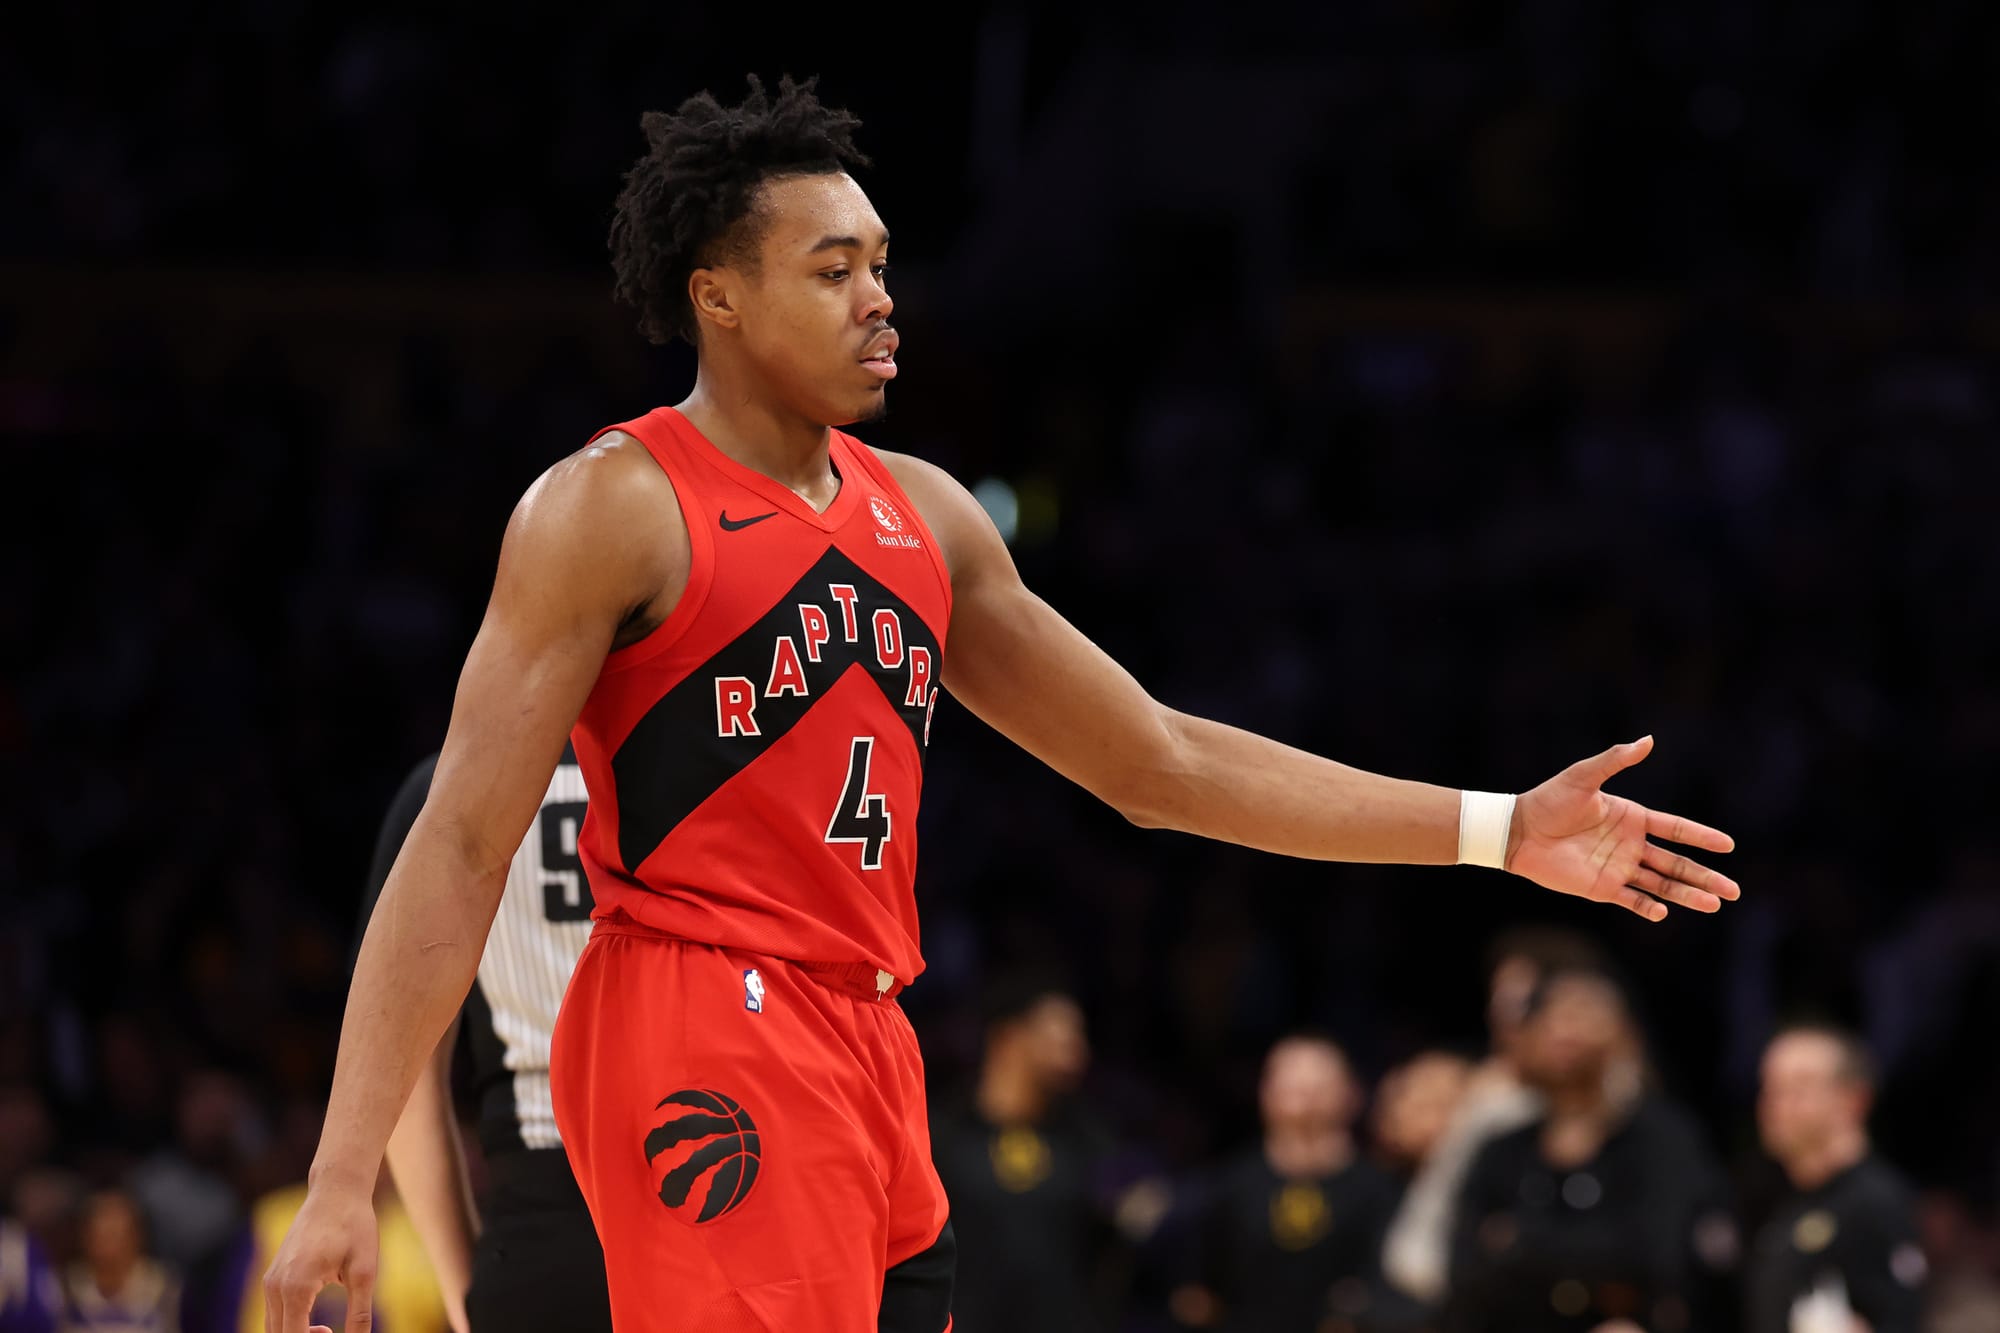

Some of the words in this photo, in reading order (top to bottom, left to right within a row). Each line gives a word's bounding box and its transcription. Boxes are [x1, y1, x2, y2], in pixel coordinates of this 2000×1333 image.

[875, 531, 899, 546] Sun
[897, 534, 921, 549] Life
[824, 736, 891, 870] 4
